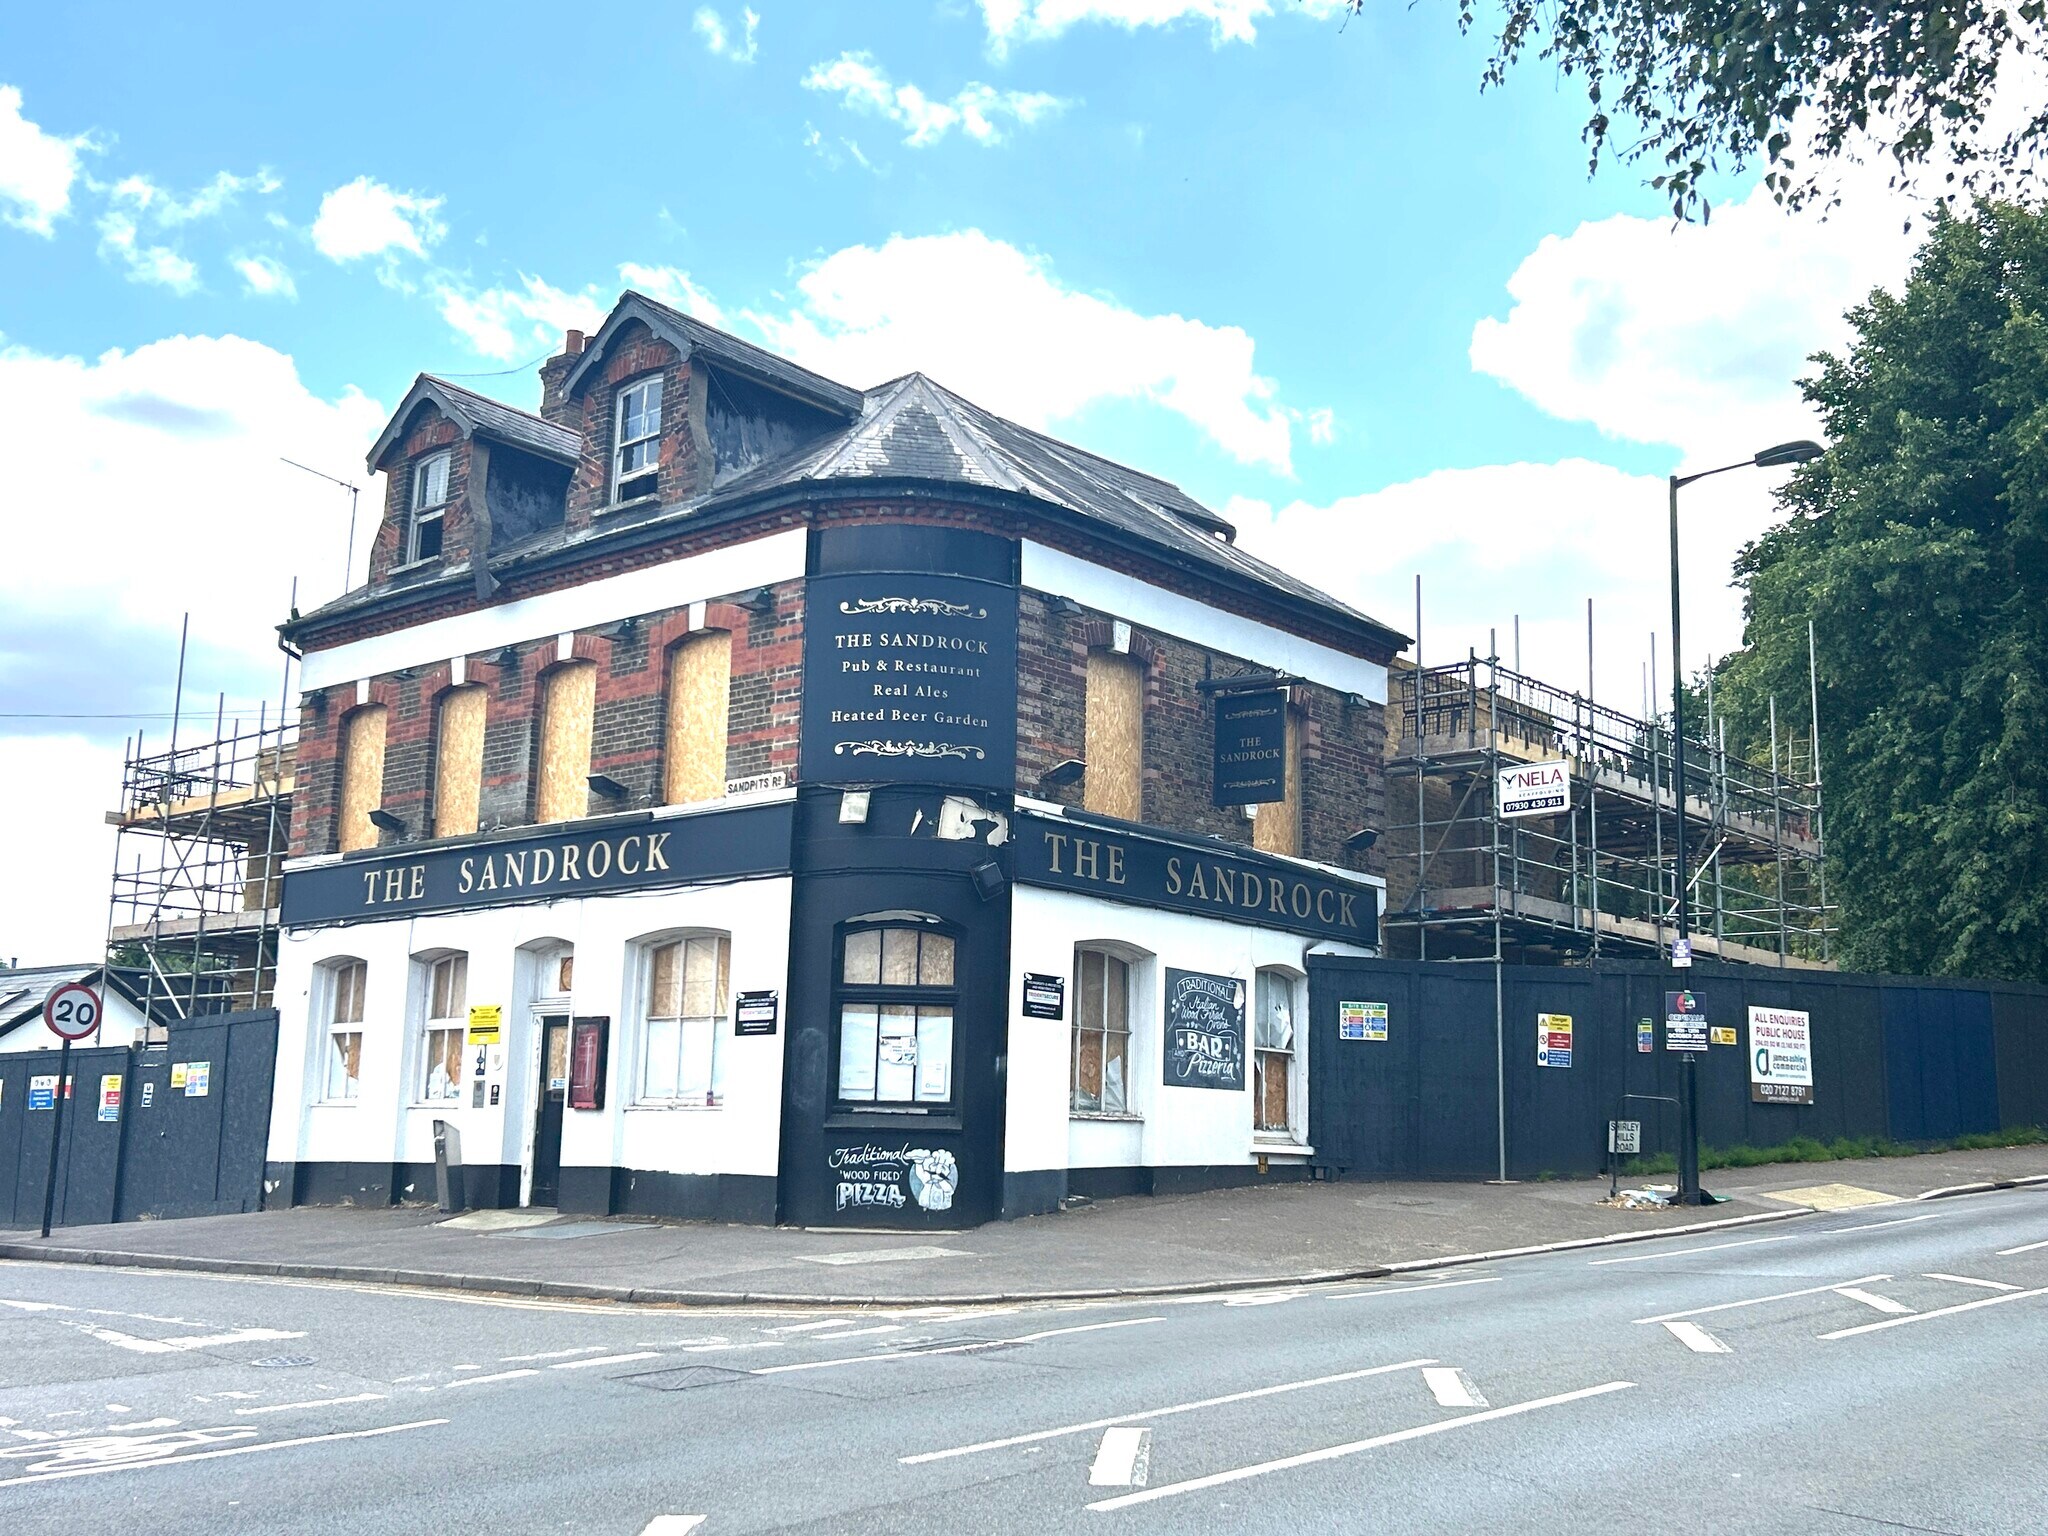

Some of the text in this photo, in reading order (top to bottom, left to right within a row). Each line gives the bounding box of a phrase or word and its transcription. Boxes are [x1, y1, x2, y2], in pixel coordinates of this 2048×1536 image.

[835, 633, 988, 655] THE SANDROCK
[842, 660, 980, 677] Pub & Restaurant
[873, 684, 948, 699] Real Ales
[831, 708, 989, 728] Heated Beer Garden
[1240, 737, 1261, 748] THE
[1220, 748, 1280, 763] SANDROCK
[727, 777, 769, 793] SANDPITS
[1518, 769, 1563, 788] NELA
[1519, 788, 1564, 798] SCAFFOLDING
[1505, 798, 1562, 812] 07930 430 911
[363, 832, 672, 905] THE SANDROCK
[1044, 831, 1358, 928] THE SANDROCK
[1181, 979, 1231, 1000] TRADITIONAL
[1180, 1001, 1226, 1020] Wood Fired
[1189, 995, 1220, 1010] Italian
[55, 999, 95, 1026] 20
[1754, 1012, 1805, 1027] ALL ENQUIRIES
[1756, 1026, 1805, 1040] PUBLIC HOUSE
[1186, 1032, 1222, 1058] BAR
[1176, 1052, 1236, 1081] Pizzeria
[1773, 1062, 1808, 1071] commercial
[1760, 1084, 1773, 1094] 020
[1774, 1085, 1789, 1096] 7127
[828, 1142, 909, 1168] Traditional
[836, 1182, 907, 1211] PIZZA
